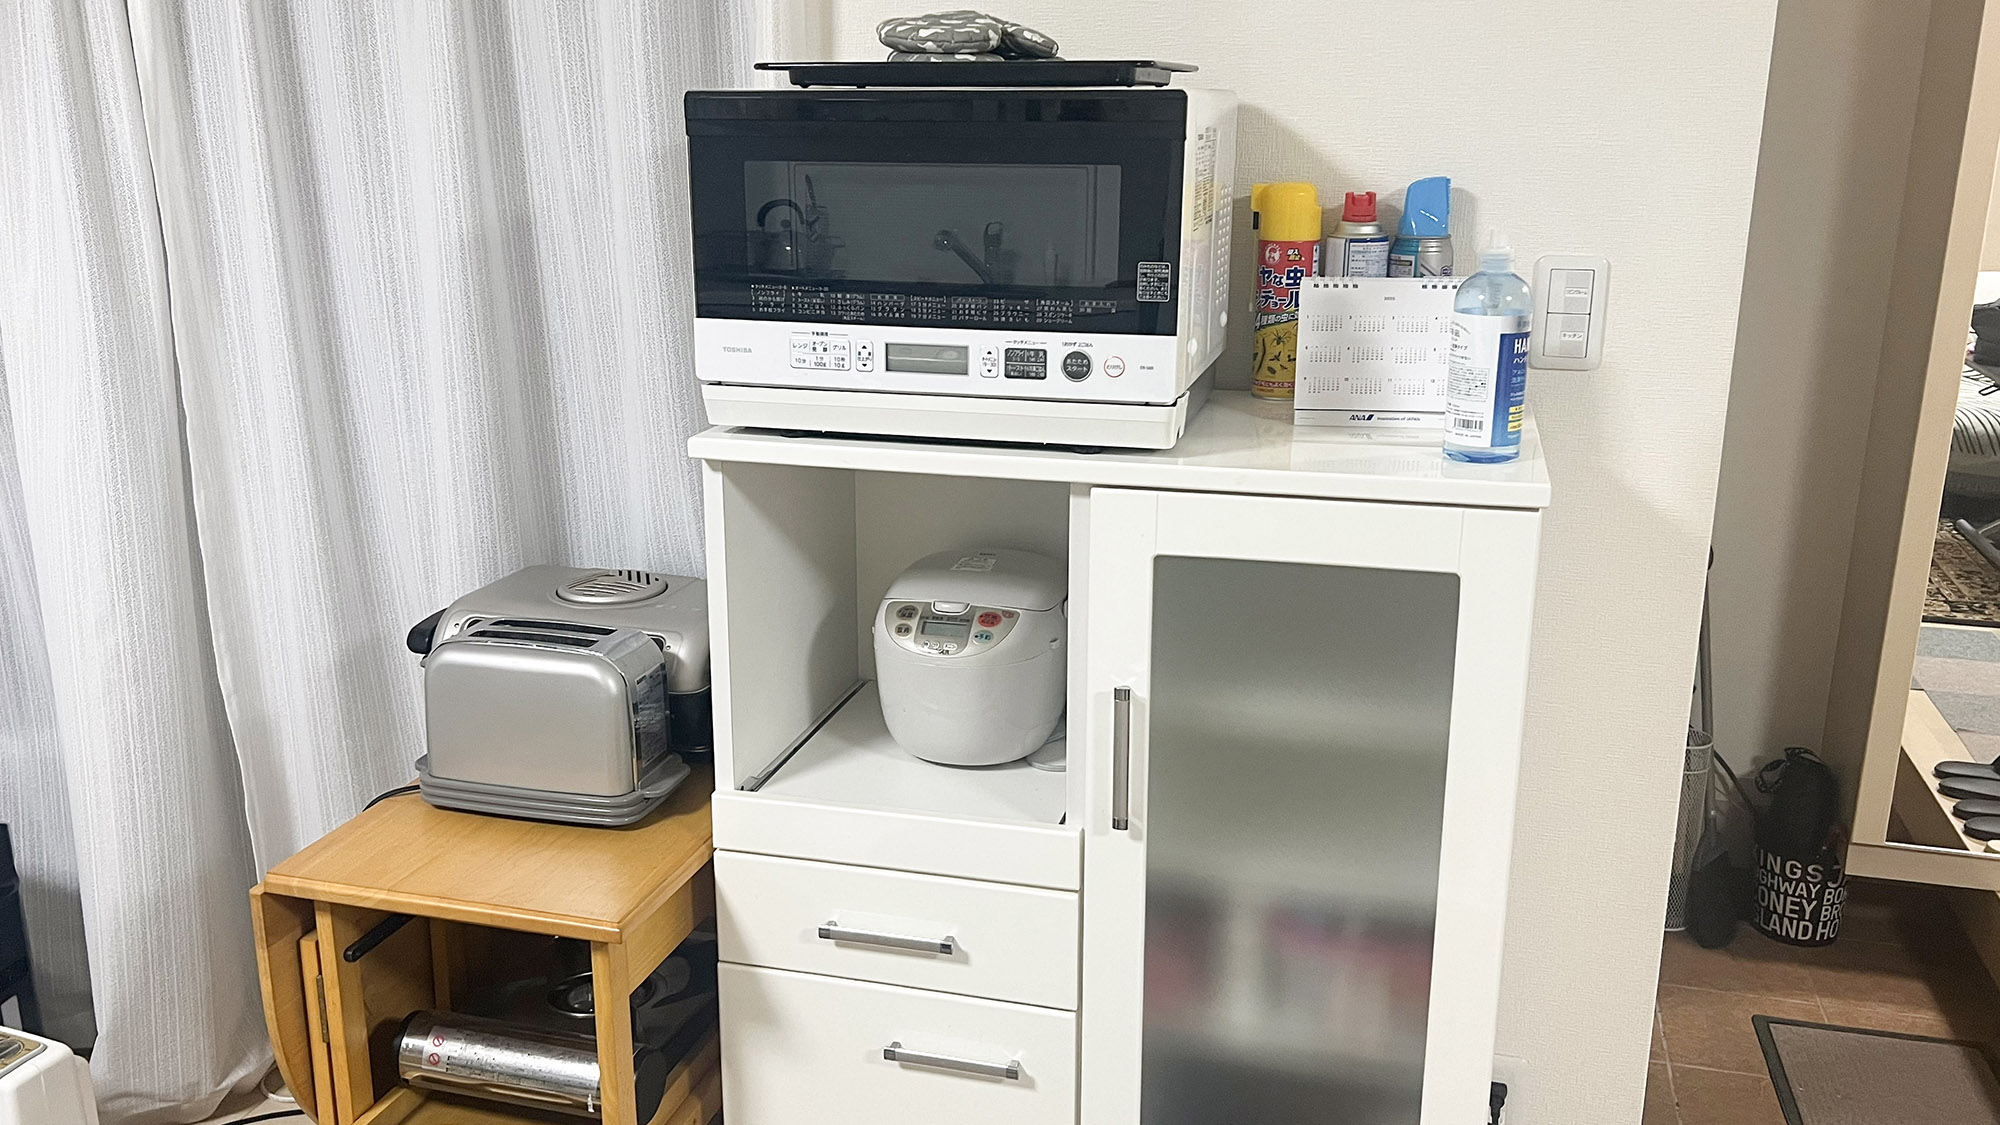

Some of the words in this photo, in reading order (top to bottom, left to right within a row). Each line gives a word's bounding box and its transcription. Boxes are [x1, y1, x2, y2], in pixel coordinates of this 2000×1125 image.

[1757, 848, 1824, 882] INGS
[1827, 864, 1844, 888] J
[1823, 887, 1846, 905] BO
